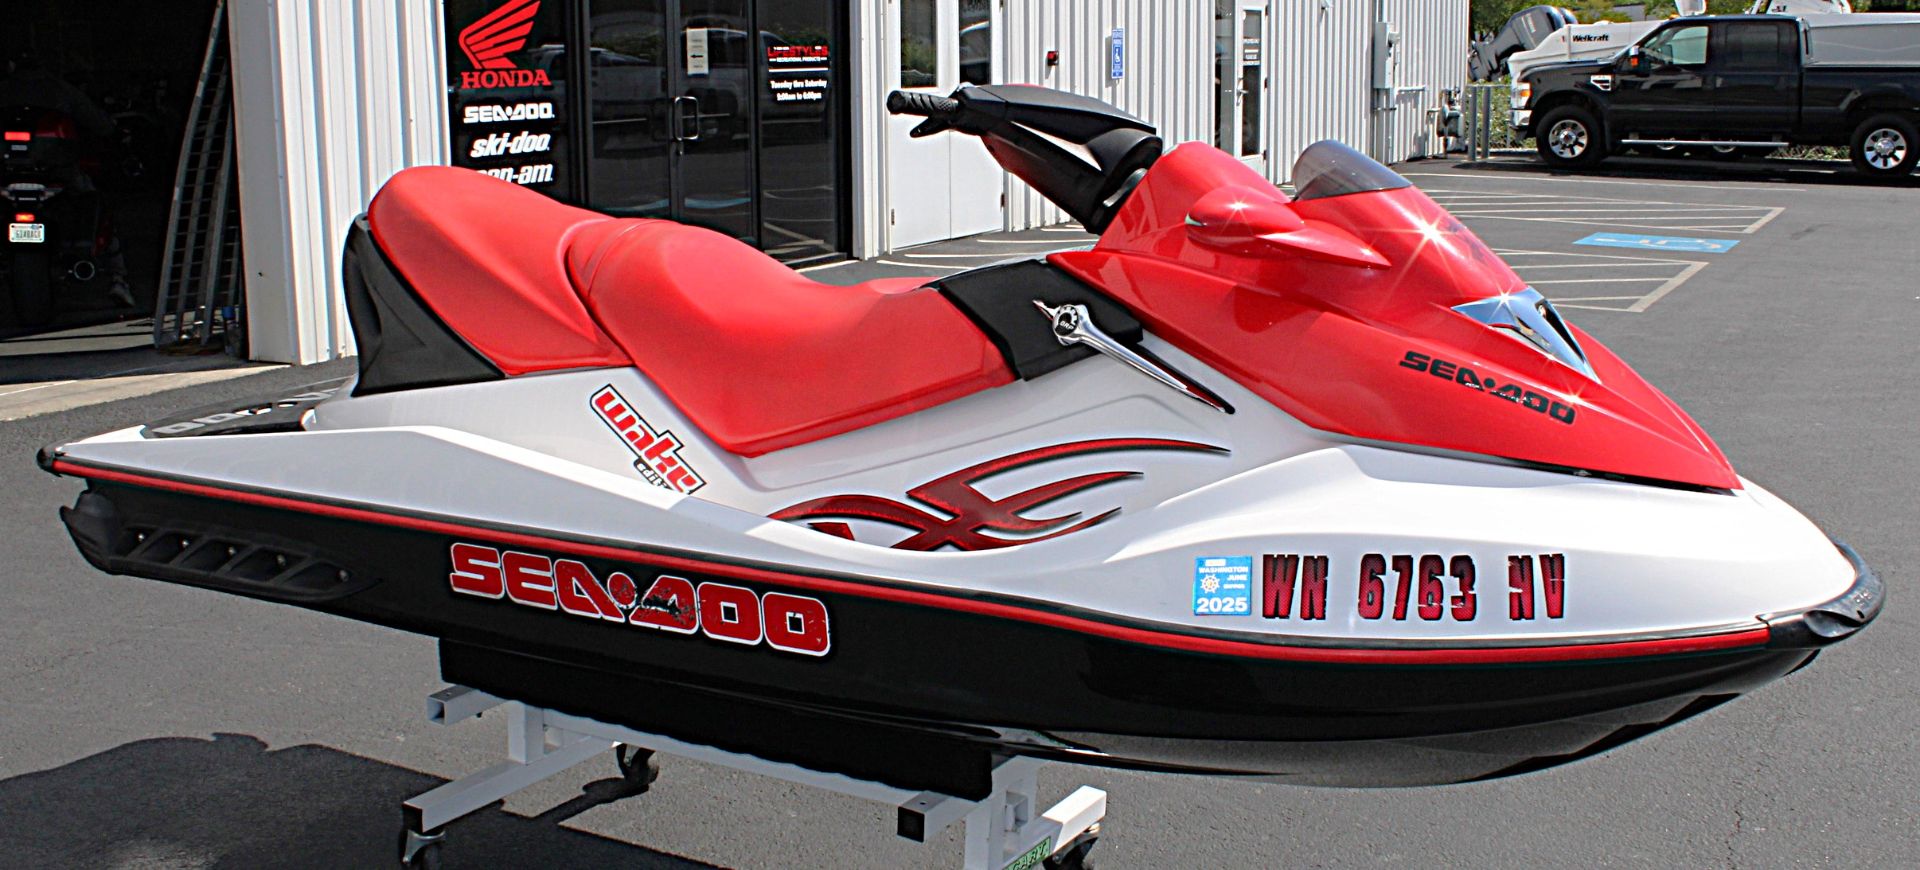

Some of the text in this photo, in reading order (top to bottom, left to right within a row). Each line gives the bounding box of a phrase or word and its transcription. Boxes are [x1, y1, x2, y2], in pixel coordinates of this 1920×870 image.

[461, 69, 552, 89] HONDA
[470, 131, 551, 158] ski-doo
[1059, 320, 1075, 330] BRP
[594, 390, 698, 493] wake
[1199, 566, 1249, 574] WASHINGTON
[1262, 554, 1330, 621] WN
[1357, 553, 1477, 622] 6763
[1196, 597, 1248, 613] 2025
